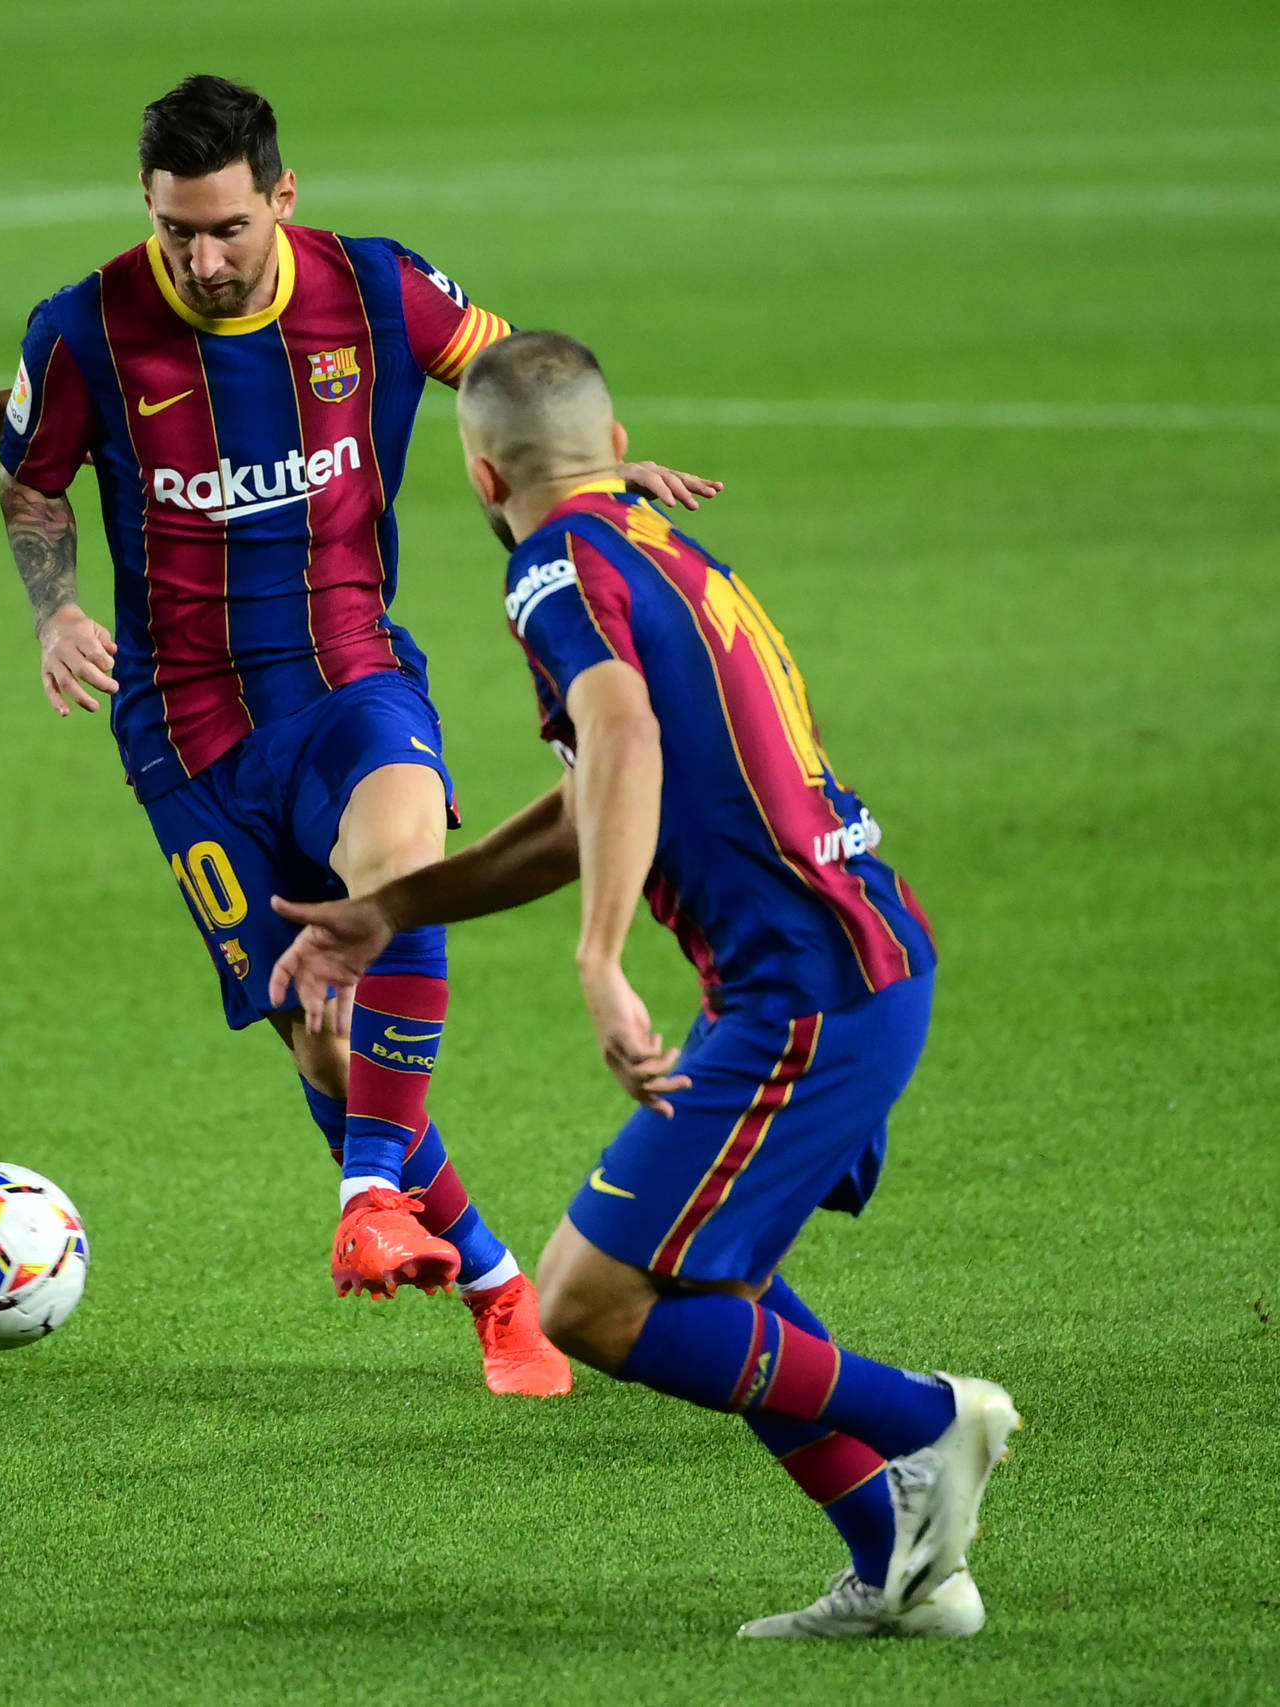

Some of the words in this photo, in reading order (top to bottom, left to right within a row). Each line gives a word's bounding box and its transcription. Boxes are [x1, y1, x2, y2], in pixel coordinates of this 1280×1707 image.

[154, 436, 361, 511] Rakuten
[171, 840, 248, 934] 10
[372, 1042, 435, 1070] BARÇ
